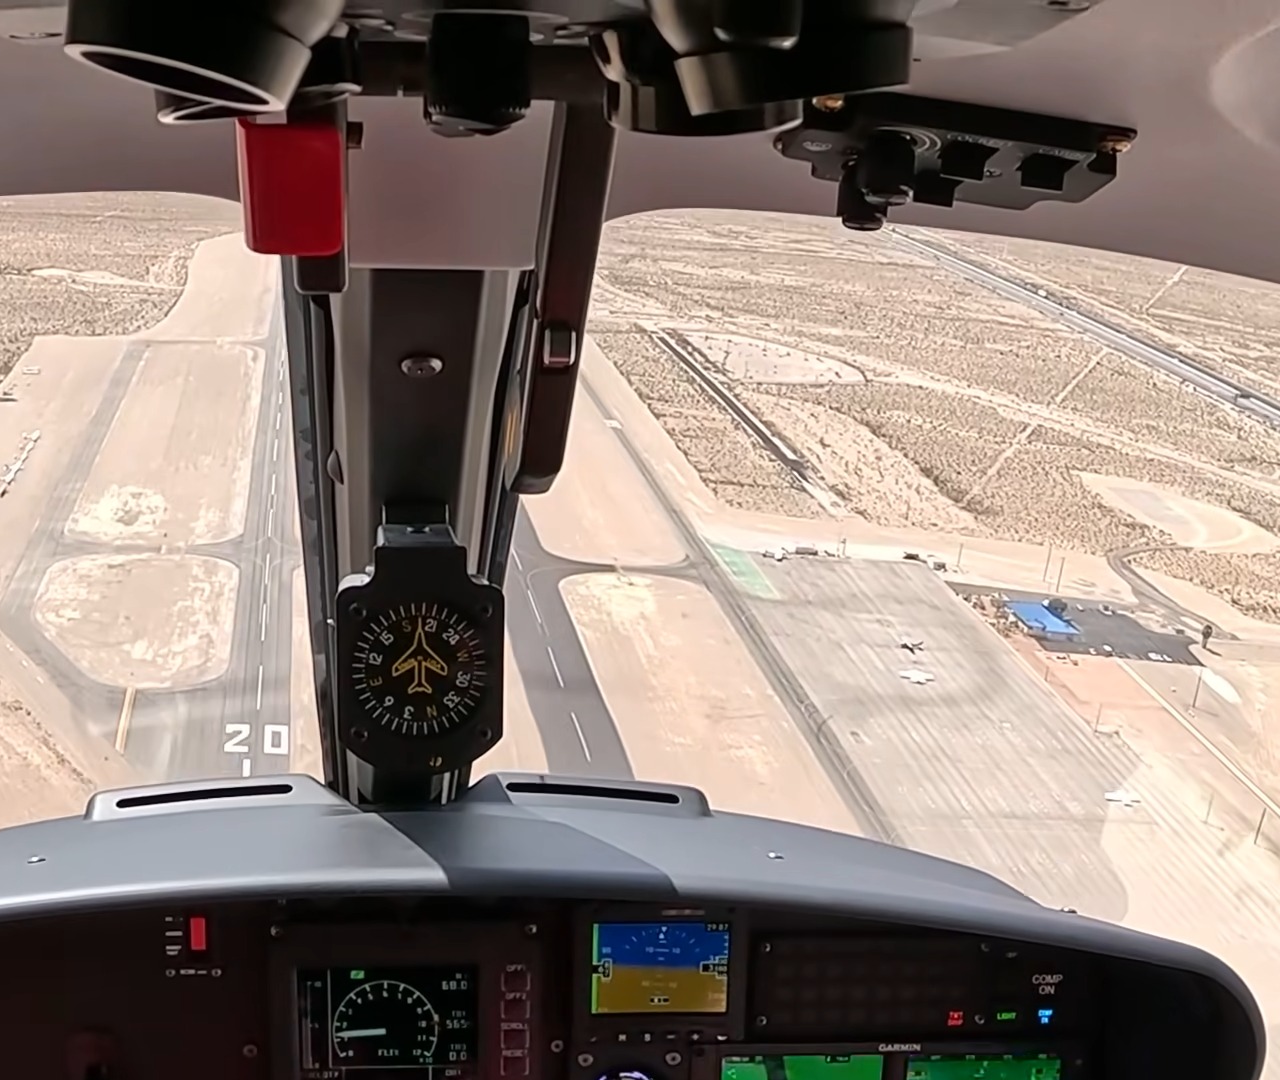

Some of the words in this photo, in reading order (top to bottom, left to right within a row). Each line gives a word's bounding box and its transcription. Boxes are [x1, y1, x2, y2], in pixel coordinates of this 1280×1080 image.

[424, 618, 438, 632] 21
[379, 631, 394, 646] 15
[442, 628, 460, 645] 24
[368, 652, 383, 665] 12
[455, 671, 470, 688] 30
[443, 691, 461, 708] 33
[403, 705, 414, 719] 3
[223, 723, 289, 755] 20
[1032, 974, 1063, 984] COMP
[1038, 984, 1055, 995] ON
[878, 1043, 921, 1052] GARMIN
